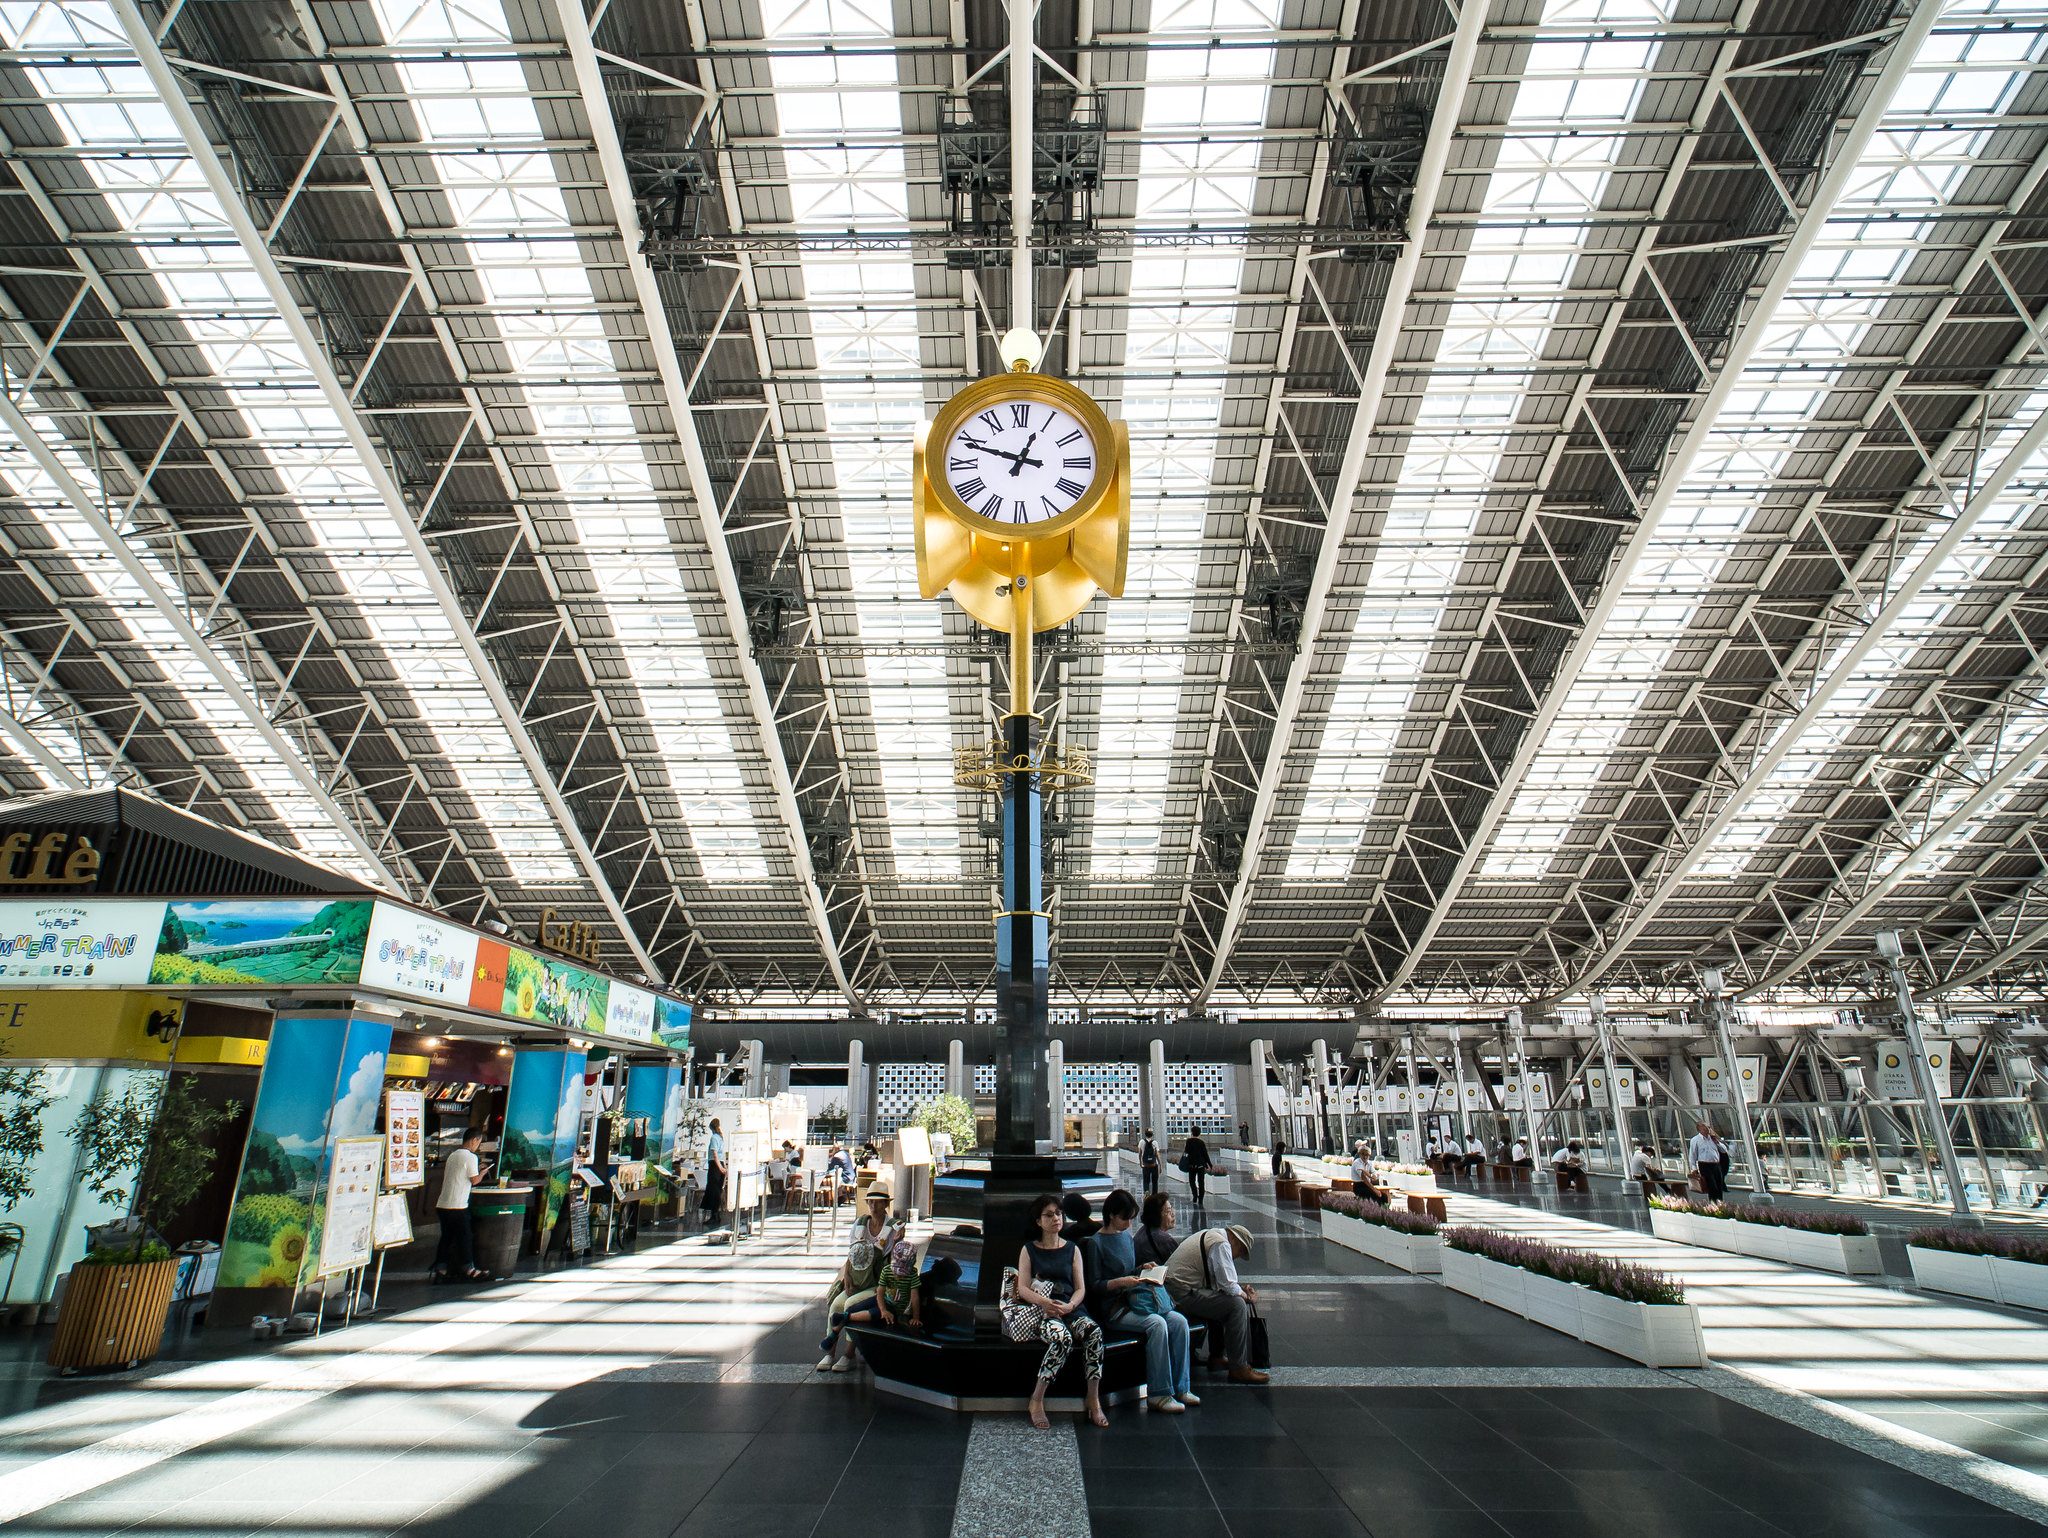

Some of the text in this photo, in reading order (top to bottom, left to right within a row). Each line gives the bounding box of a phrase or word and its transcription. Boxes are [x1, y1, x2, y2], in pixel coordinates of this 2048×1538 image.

[978, 409, 1004, 436] XI
[1010, 404, 1031, 428] XII
[1040, 411, 1057, 433] I
[957, 430, 987, 448] X
[1055, 429, 1083, 448] II
[950, 456, 978, 472] IX
[1063, 456, 1091, 470] III
[954, 476, 987, 504] VIII
[979, 493, 1004, 520] VII
[1014, 501, 1028, 524] VI
[1040, 495, 1063, 518] V
[0, 933, 138, 959] MMER TRAIN!
[538, 908, 600, 964] Caffè
[379, 939, 427, 971] SUMMER
[428, 954, 465, 981] TRAIN!
